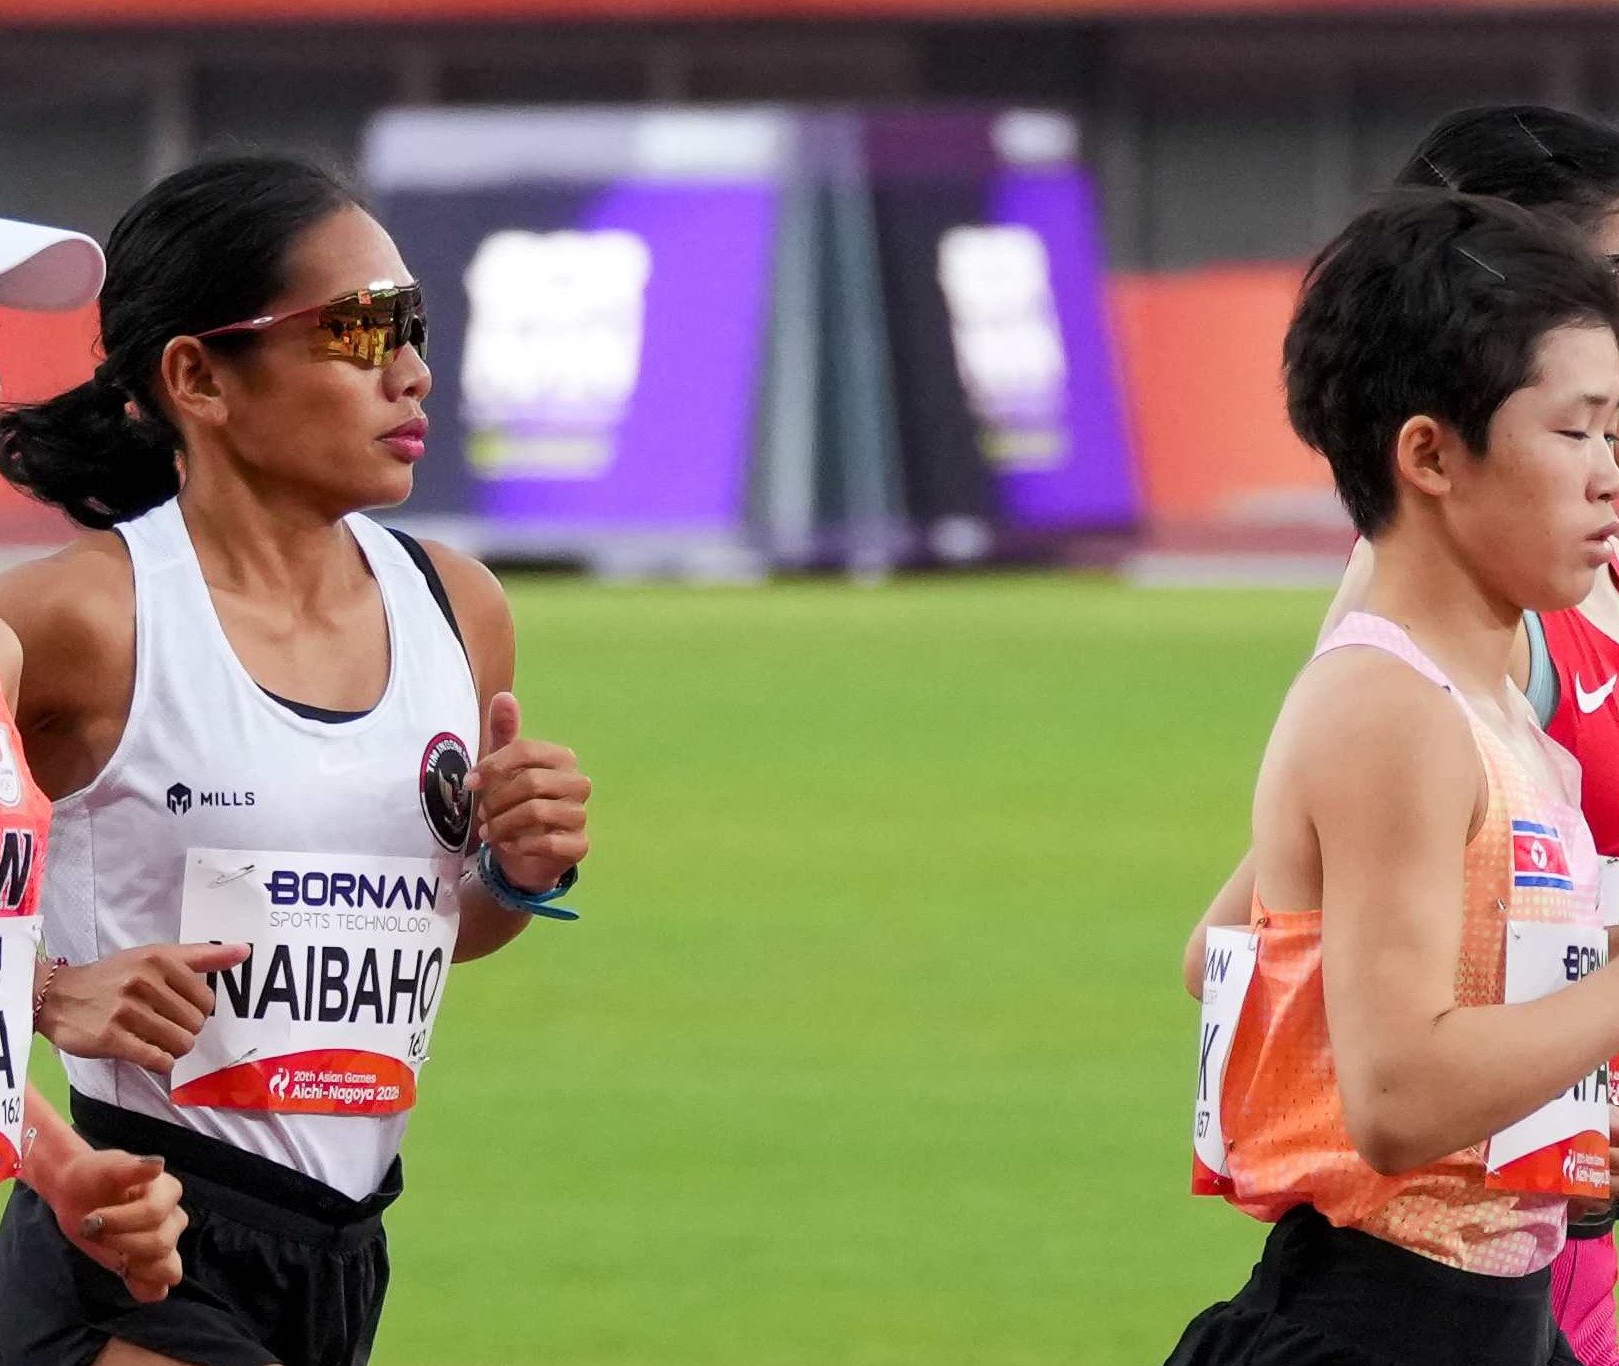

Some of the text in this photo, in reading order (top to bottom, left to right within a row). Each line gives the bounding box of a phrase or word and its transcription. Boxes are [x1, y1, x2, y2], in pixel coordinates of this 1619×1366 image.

[199, 791, 256, 807] MILLS
[264, 869, 440, 911] BORNAN
[269, 910, 330, 930] SPORTS
[207, 939, 443, 1025] NAIBAHO
[293, 1070, 377, 1083] 20th Asian Games
[291, 1082, 375, 1105] Aichi-Nagoya
[2, 1097, 21, 1125] 162
